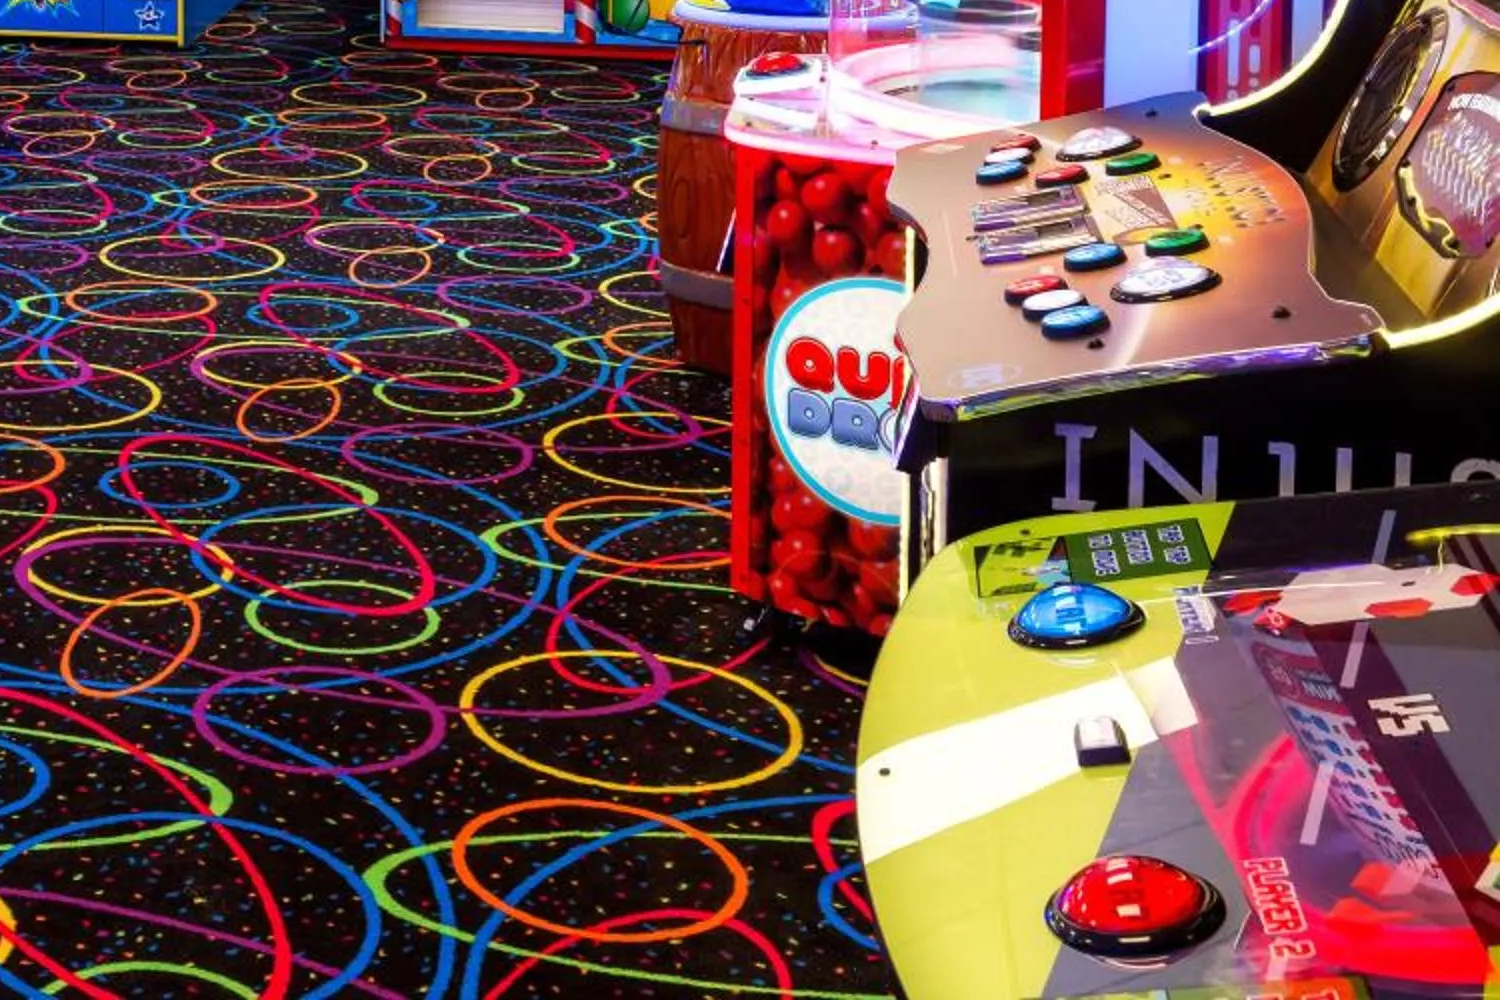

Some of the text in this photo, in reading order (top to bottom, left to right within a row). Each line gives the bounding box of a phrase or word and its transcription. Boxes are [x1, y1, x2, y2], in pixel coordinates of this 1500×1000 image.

[1051, 422, 1500, 512] INJU
[1367, 693, 1451, 738] VS
[1242, 856, 1308, 936] PLAYER
[1269, 937, 1317, 961] 2
